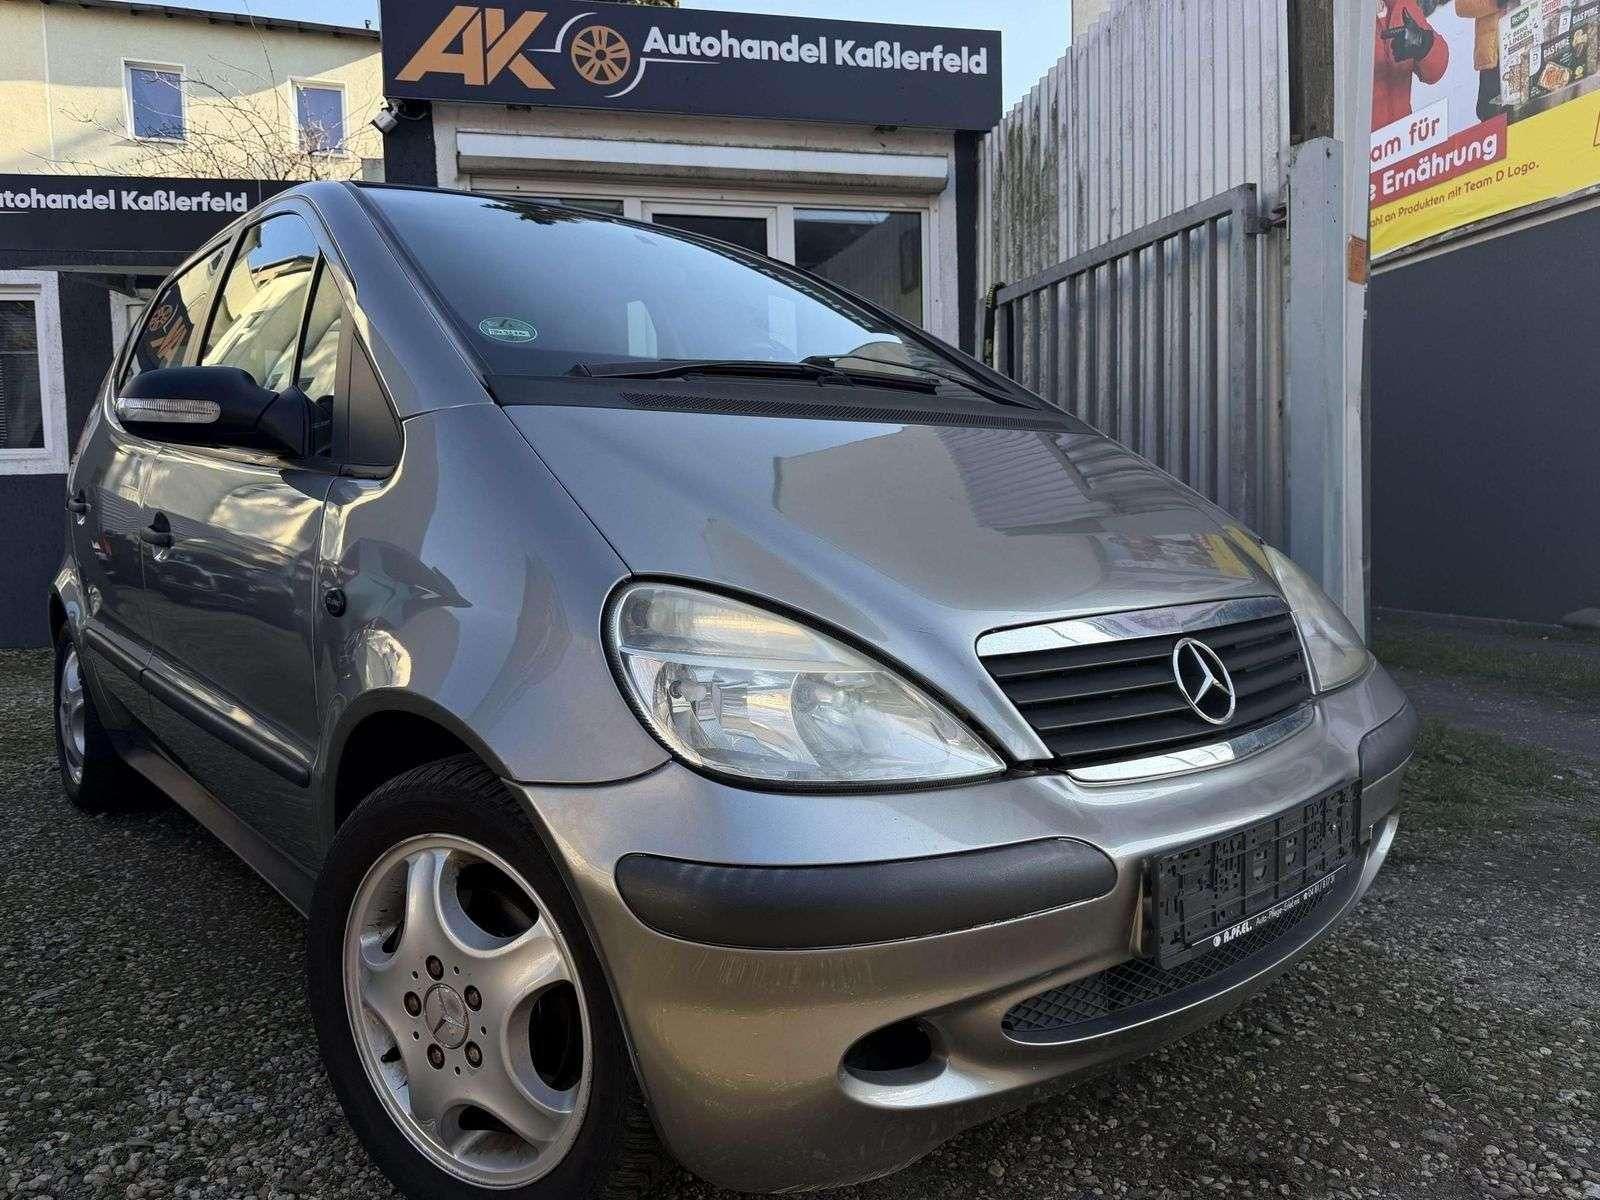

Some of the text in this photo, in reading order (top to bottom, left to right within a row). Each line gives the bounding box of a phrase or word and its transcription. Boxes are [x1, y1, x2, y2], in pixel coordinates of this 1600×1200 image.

[395, 5, 556, 90] AK
[643, 27, 988, 74] Autohandel Kaßlerfeld
[1371, 117, 1440, 163] am für
[1382, 133, 1498, 195] Ernährung
[121, 190, 248, 212] Kaßlerfeld
[1385, 211, 1396, 222] an
[1398, 194, 1445, 217] Produkten
[1448, 186, 1461, 200] mit
[1464, 176, 1493, 194] Team
[1496, 170, 1505, 182] D
[1507, 160, 1540, 177] Logo.
